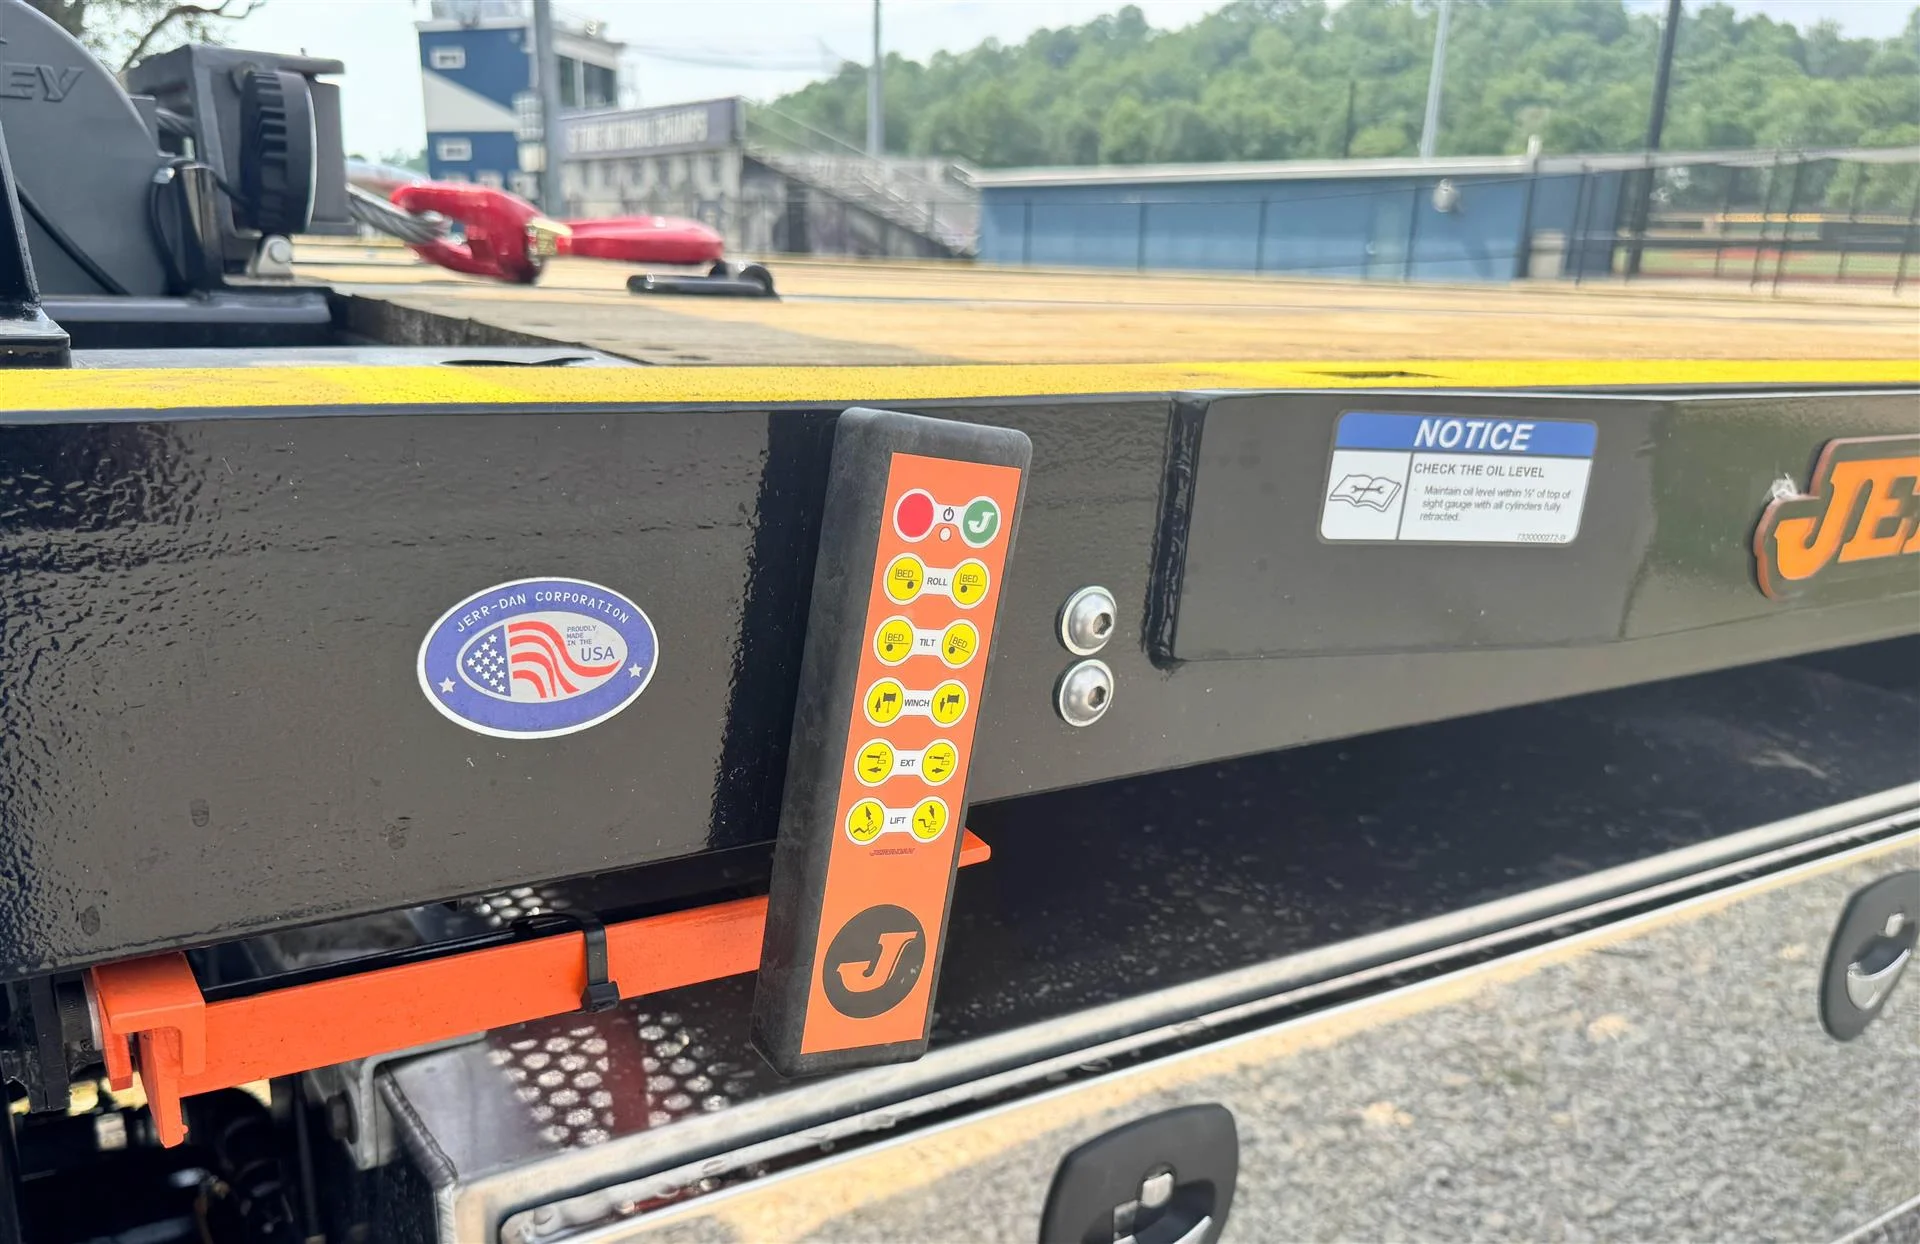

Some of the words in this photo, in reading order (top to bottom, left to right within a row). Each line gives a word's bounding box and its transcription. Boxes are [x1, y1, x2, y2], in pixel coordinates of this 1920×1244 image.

[1414, 419, 1535, 451] NOTICE
[1414, 463, 1456, 475] CHECK
[1460, 464, 1484, 476] THE
[1487, 465, 1505, 477] OIL
[1508, 466, 1545, 478] LEVEL
[1424, 486, 1461, 496] Maintain
[1463, 487, 1473, 496] oil
[1475, 487, 1495, 497] level
[1497, 488, 1521, 497] within
[1536, 488, 1546, 498] of
[1547, 489, 1560, 500] top
[1562, 490, 1572, 499] of
[1422, 499, 1444, 510] sight
[1445, 501, 1472, 511] gauge
[1474, 500, 1491, 509] with
[1493, 500, 1503, 509] all
[1505, 501, 1543, 512] cylinders
[1544, 502, 1561, 512] fully
[968, 511, 994, 534] J
[1420, 512, 1460, 521] retracted.
[1774, 456, 1920, 580] JE
[896, 569, 914, 579] BED
[961, 574, 979, 583] BED
[927, 577, 948, 586] ROLL
[456, 593, 527, 633] JERR-DAN
[535, 591, 629, 624] CORPORATION
[887, 633, 905, 642] BED
[919, 638, 936, 647] TILT
[952, 637, 969, 649] BED
[581, 646, 615, 662] USA
[904, 699, 930, 708] WINCH
[900, 759, 916, 767] EXT
[890, 816, 906, 825] LIFT
[836, 931, 918, 993] J
